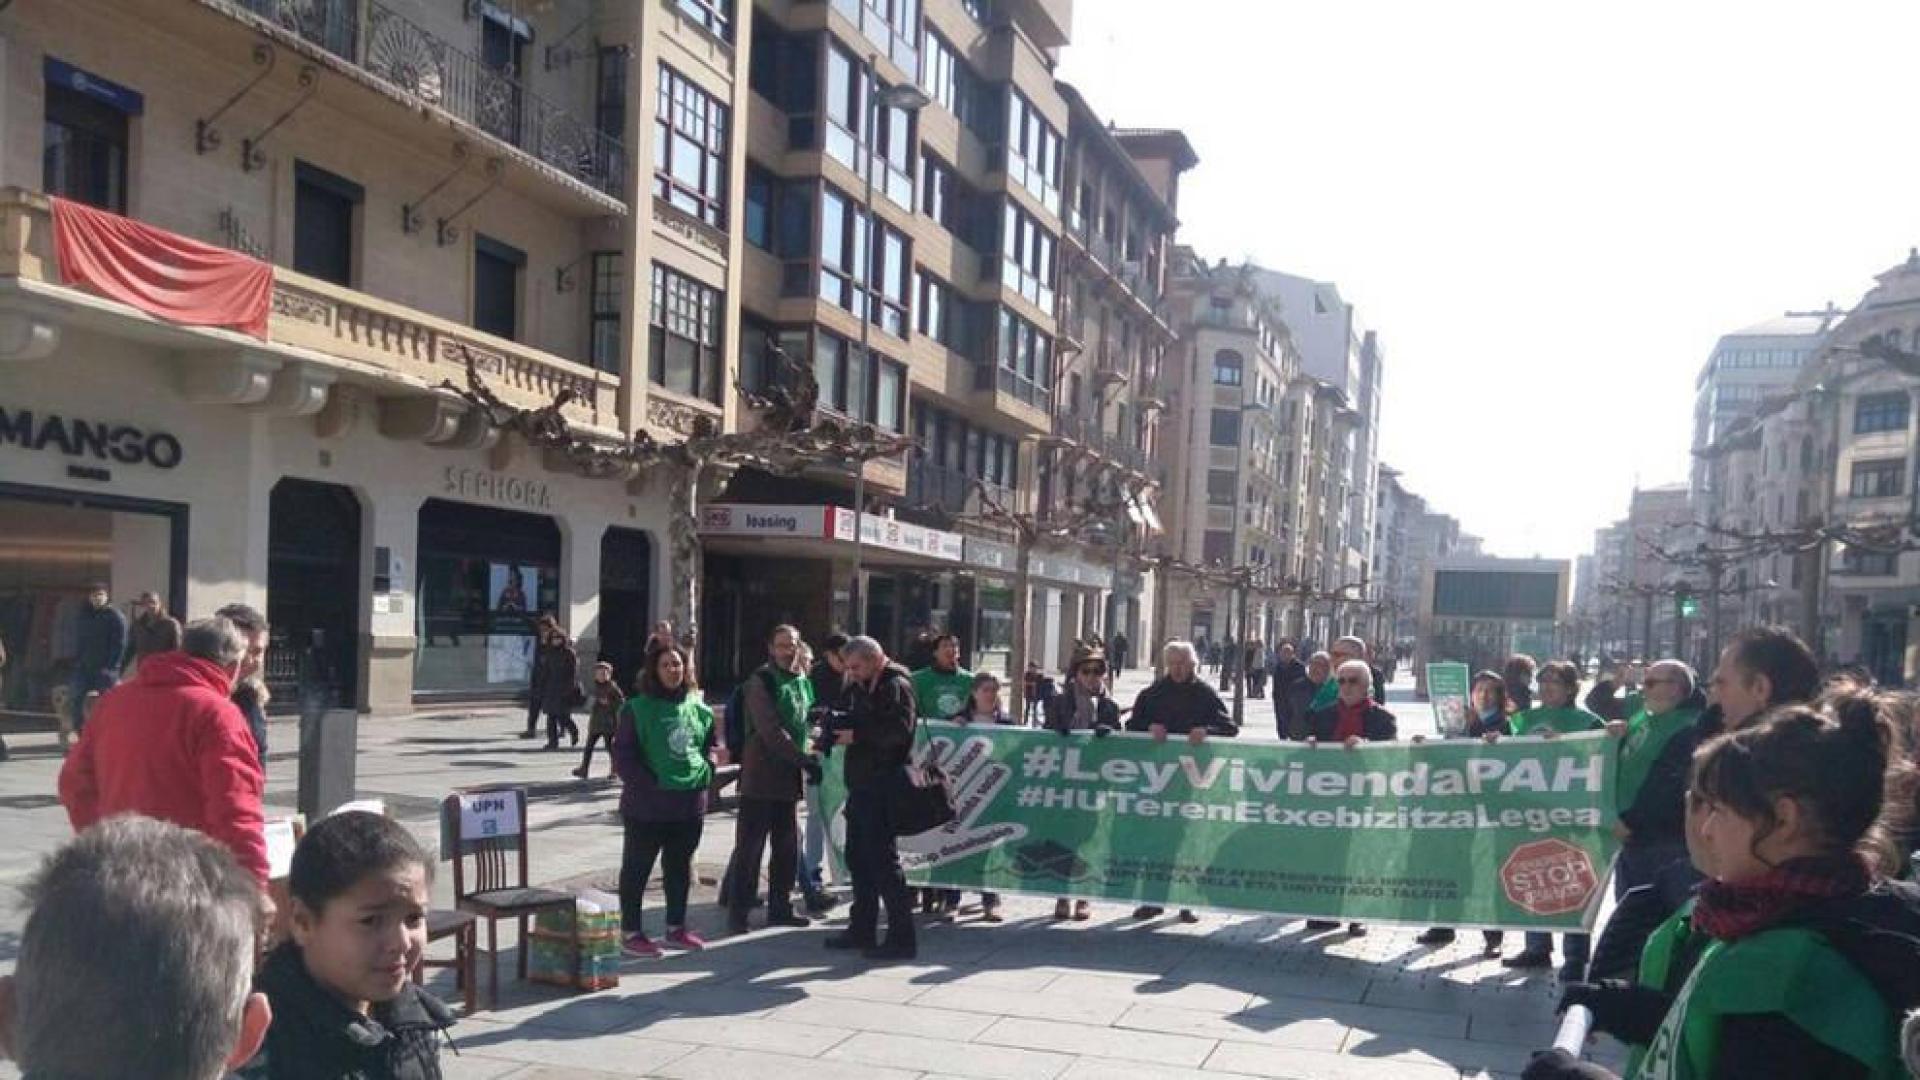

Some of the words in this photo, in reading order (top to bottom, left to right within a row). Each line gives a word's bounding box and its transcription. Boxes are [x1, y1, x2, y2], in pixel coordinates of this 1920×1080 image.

[0, 405, 182, 468] MANGO
[444, 465, 552, 510] SEPHORA
[745, 514, 796, 531] leasing
[1023, 746, 1603, 797] #LeyViviendaPAH
[472, 798, 505, 813] UPN
[1017, 786, 1601, 832] #HUTerenEtxebizitzaLegea
[1512, 861, 1587, 892] STOP
